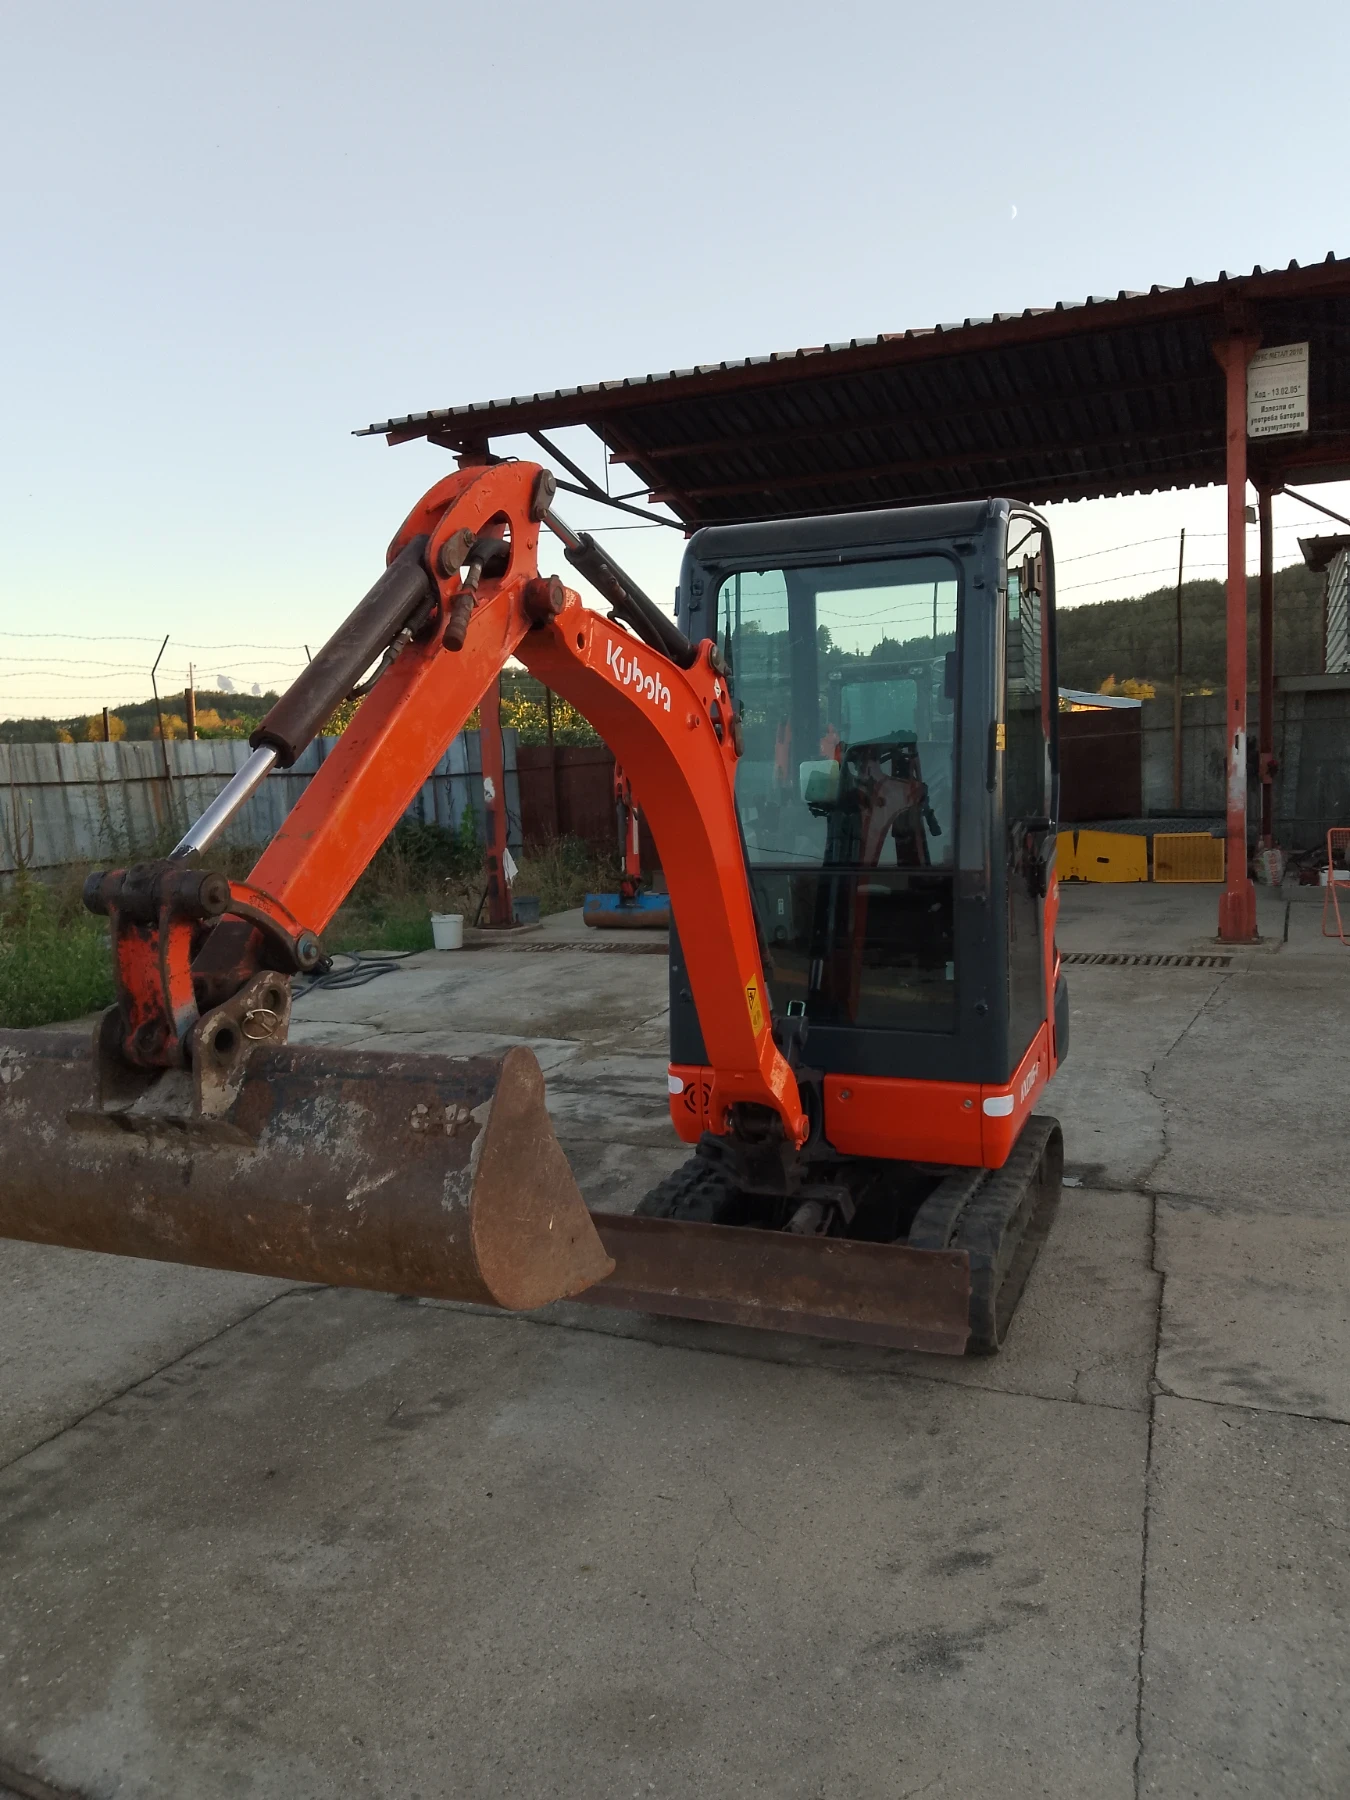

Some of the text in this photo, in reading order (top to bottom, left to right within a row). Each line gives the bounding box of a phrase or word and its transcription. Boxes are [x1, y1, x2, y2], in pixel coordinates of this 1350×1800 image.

[1251, 411, 1304, 425] употреба батерии
[1261, 422, 1300, 432] акумулатори
[606, 639, 671, 712] Kubota
